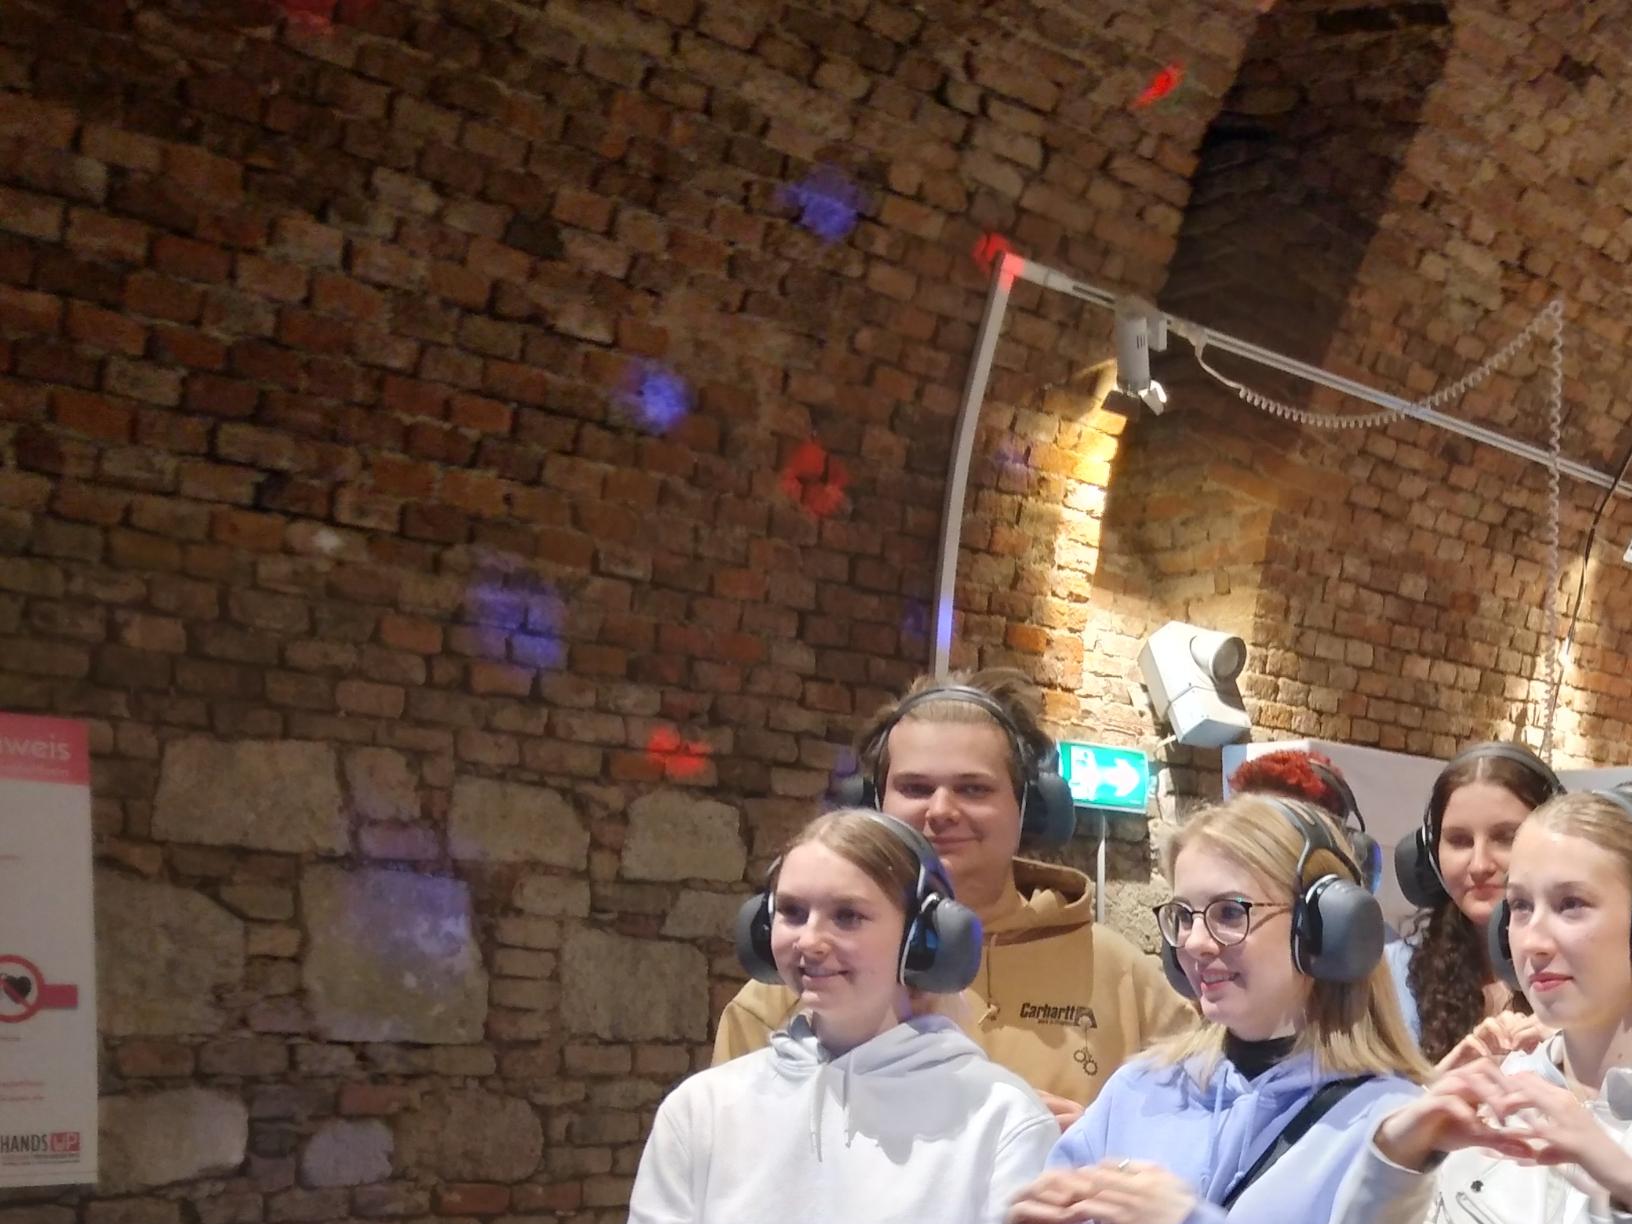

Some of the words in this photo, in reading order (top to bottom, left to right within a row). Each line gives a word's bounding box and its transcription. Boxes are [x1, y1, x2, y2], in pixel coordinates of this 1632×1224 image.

[0, 734, 71, 760] weis
[1020, 1002, 1076, 1021] Carhartt
[0, 1133, 48, 1153] HANDS
